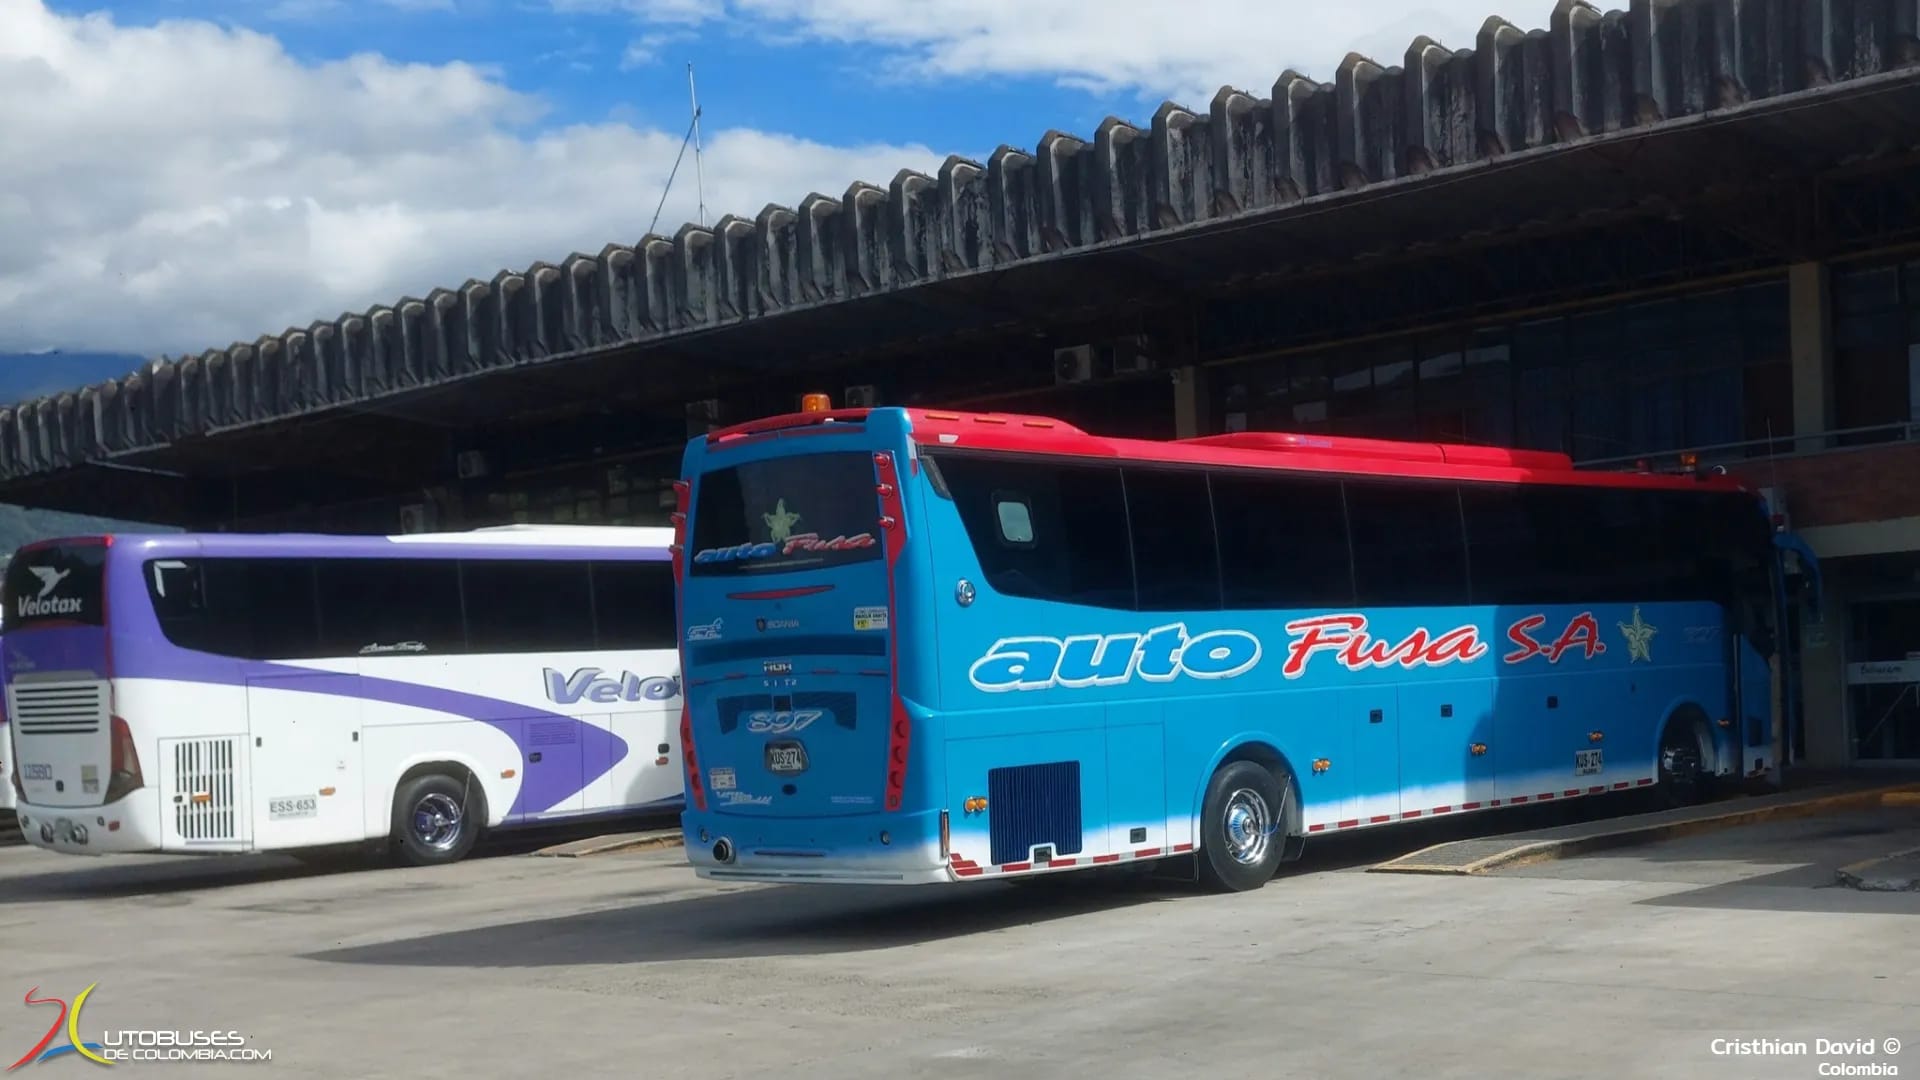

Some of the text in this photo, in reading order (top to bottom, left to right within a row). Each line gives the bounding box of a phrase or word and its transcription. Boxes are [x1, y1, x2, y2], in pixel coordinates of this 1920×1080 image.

[782, 533, 876, 555] Fusa
[17, 594, 82, 617] Velotax
[968, 611, 1606, 692] auto Fusa S.A.
